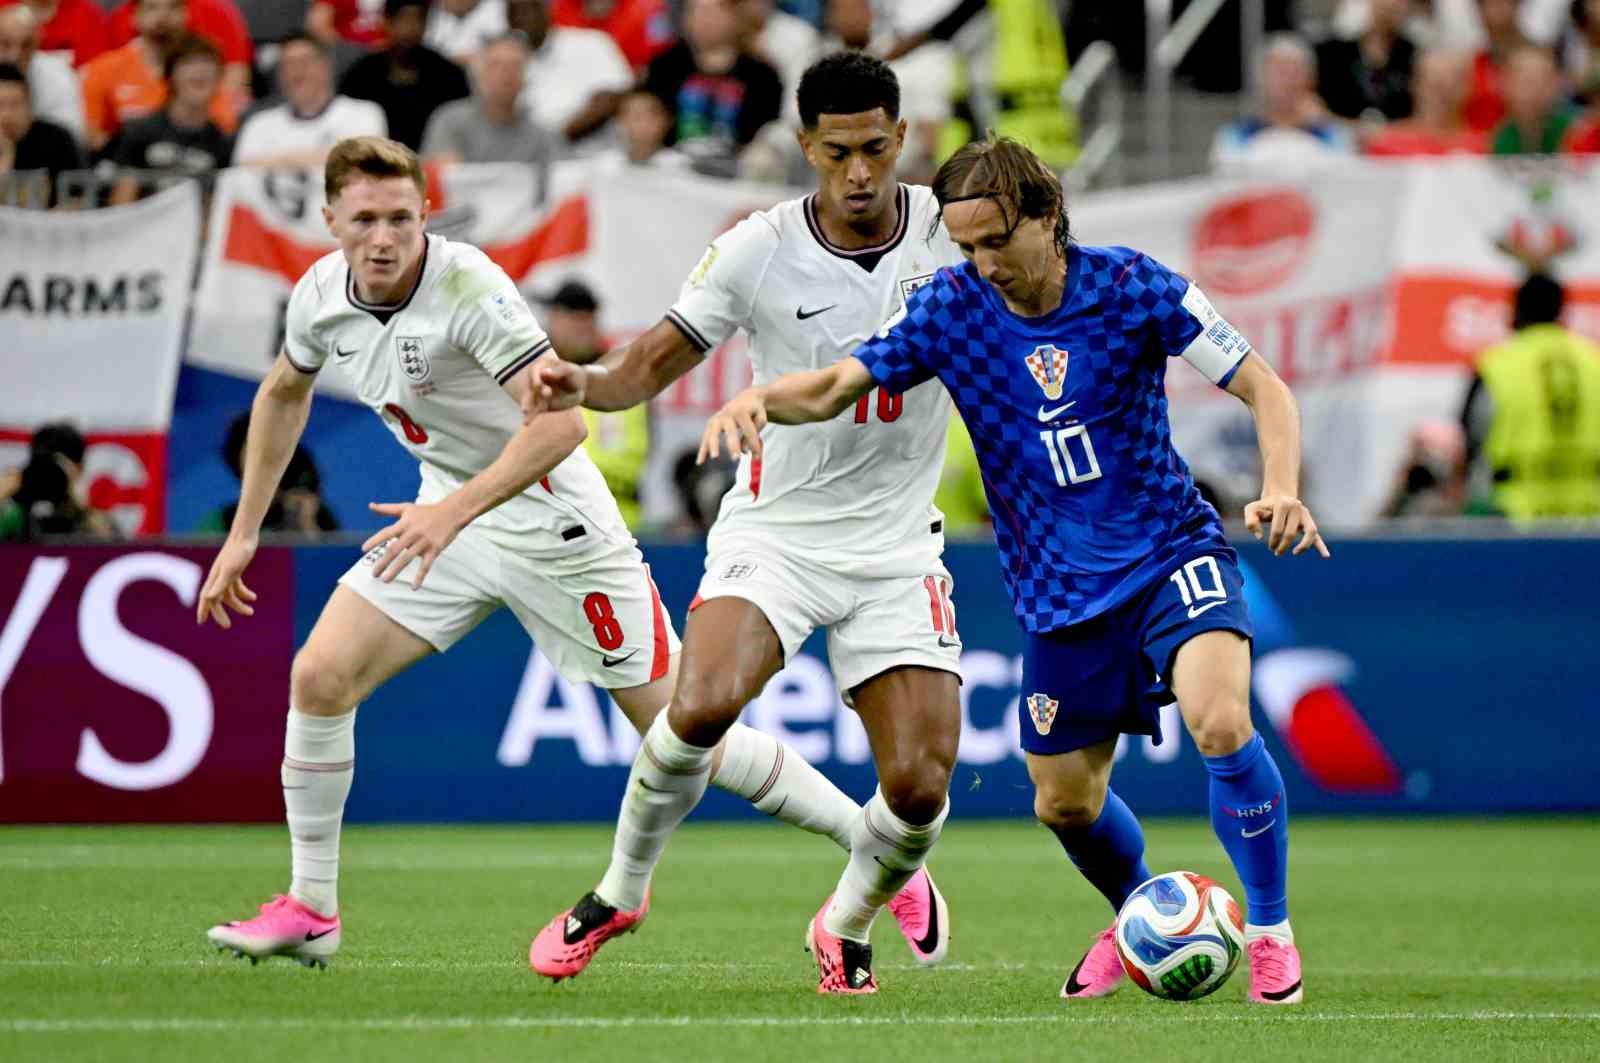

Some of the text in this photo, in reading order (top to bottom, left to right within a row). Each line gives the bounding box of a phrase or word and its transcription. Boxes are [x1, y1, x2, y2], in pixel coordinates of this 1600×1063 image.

[1, 273, 164, 315] ARMS
[1039, 424, 1102, 487] 10
[1169, 555, 1227, 606] 10
[582, 591, 625, 651] 8
[1236, 800, 1273, 817] HNS
